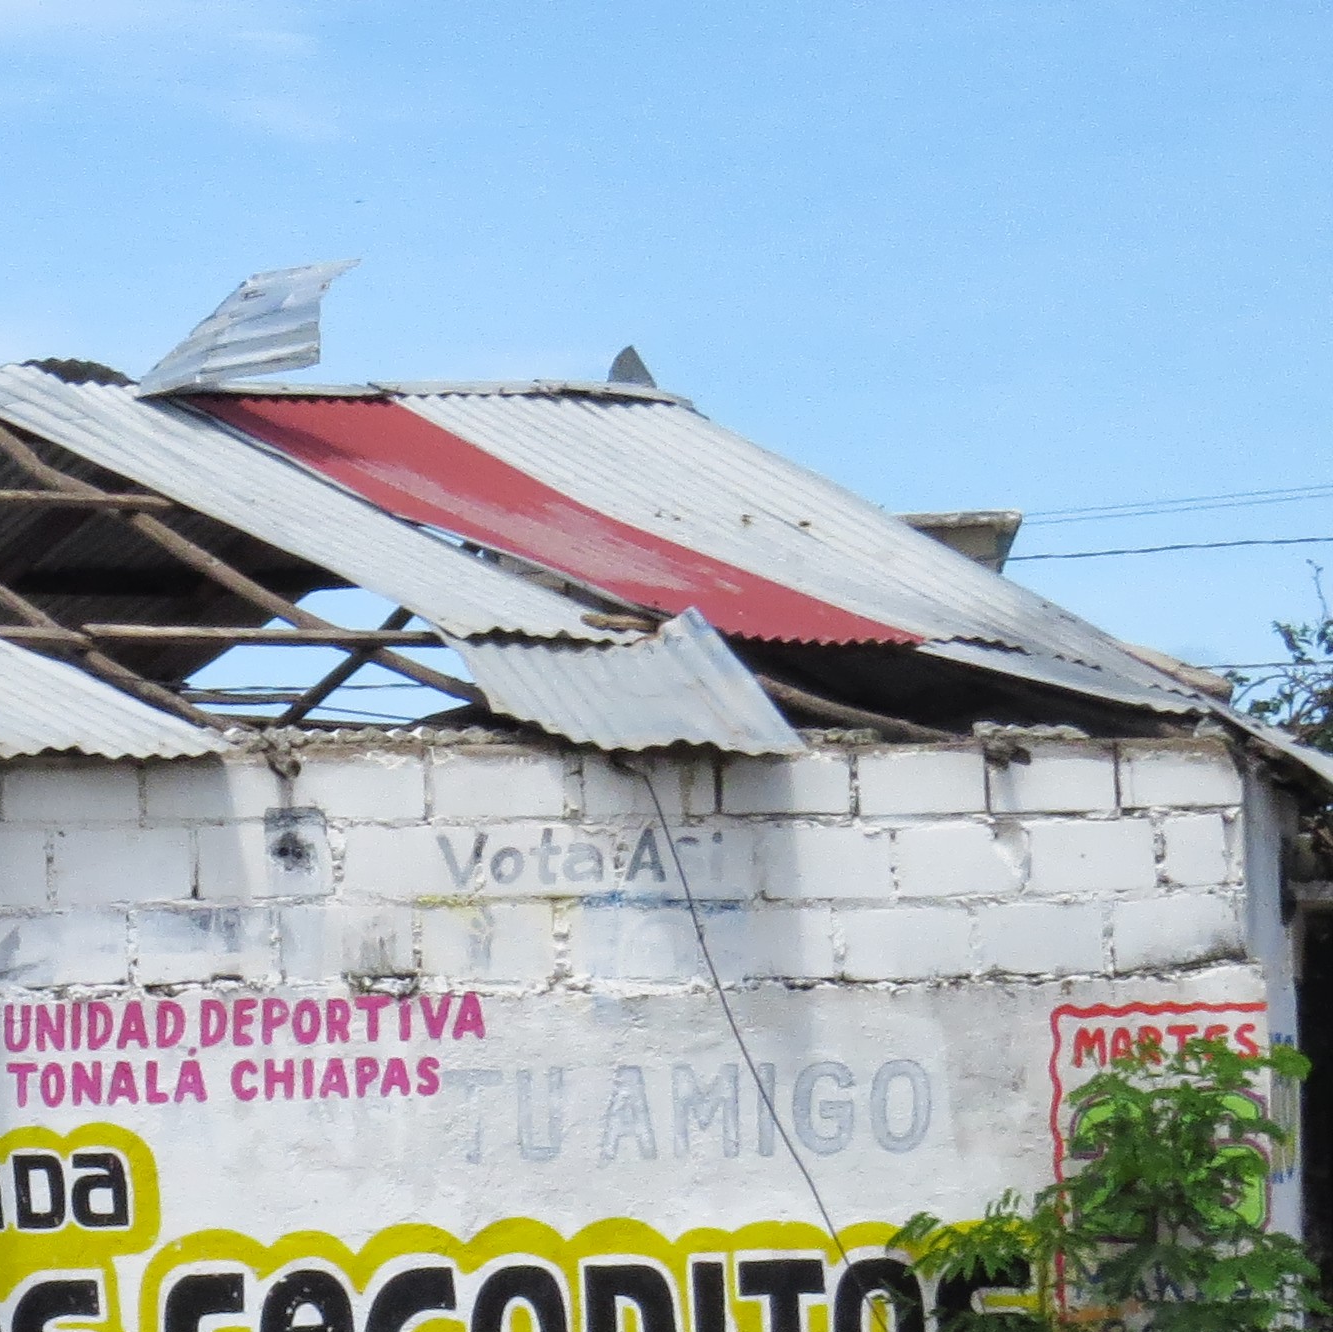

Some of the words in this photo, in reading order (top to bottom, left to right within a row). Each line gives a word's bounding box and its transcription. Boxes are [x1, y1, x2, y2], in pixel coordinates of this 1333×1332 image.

[436, 827, 604, 889] Vota
[3, 999, 187, 1054] UNIDAD
[199, 990, 487, 1049] DEPORTIVA
[230, 1056, 442, 1101] CHIAPAS
[441, 1065, 564, 1164] TU
[599, 1058, 932, 1162] AMIGO
